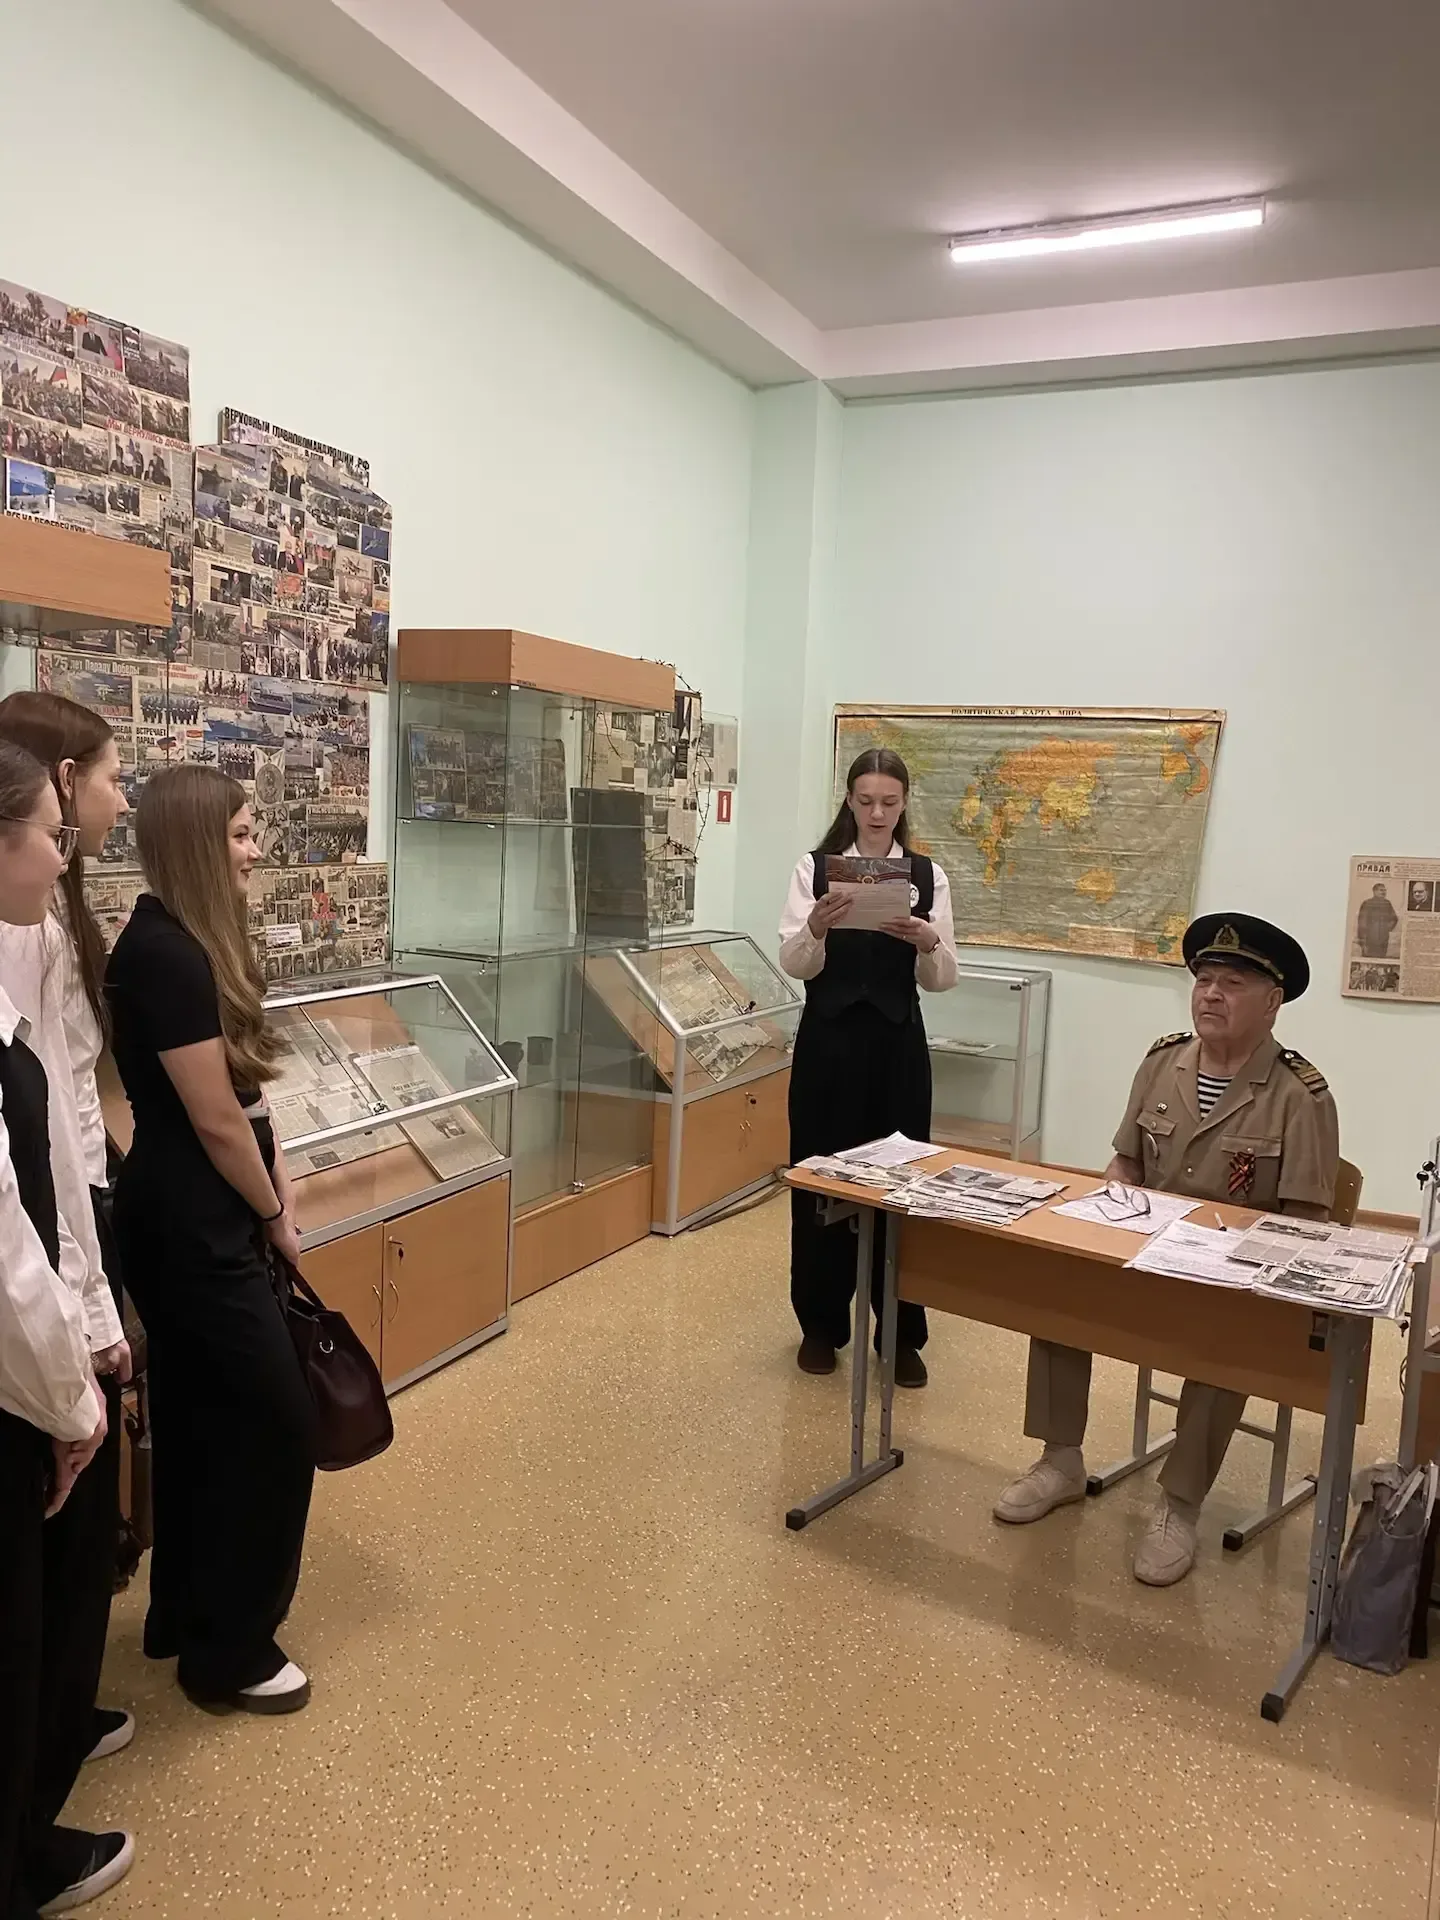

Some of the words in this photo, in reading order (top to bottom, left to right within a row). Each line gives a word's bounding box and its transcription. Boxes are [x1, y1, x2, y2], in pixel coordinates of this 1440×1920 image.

[224, 406, 270, 434] ВЕРХОВНЫЙ
[272, 424, 355, 467] ГЛАВНОКОМАНДУЮЩИЙ
[357, 455, 370, 471] РФ
[53, 655, 69, 671] 75
[69, 660, 84, 671] лет
[84, 659, 112, 675] Параду
[112, 661, 141, 676] Победы
[951, 708, 1016, 716] ПОЛИТИЧЕСКАЯ
[1022, 708, 1052, 716] КАРТА
[1058, 709, 1083, 717] МИРА
[111, 724, 133, 735] ОБЕДА
[136, 726, 167, 737] ВСТРЕЧАЕТ
[1356, 863, 1391, 873] ПРАВДА
